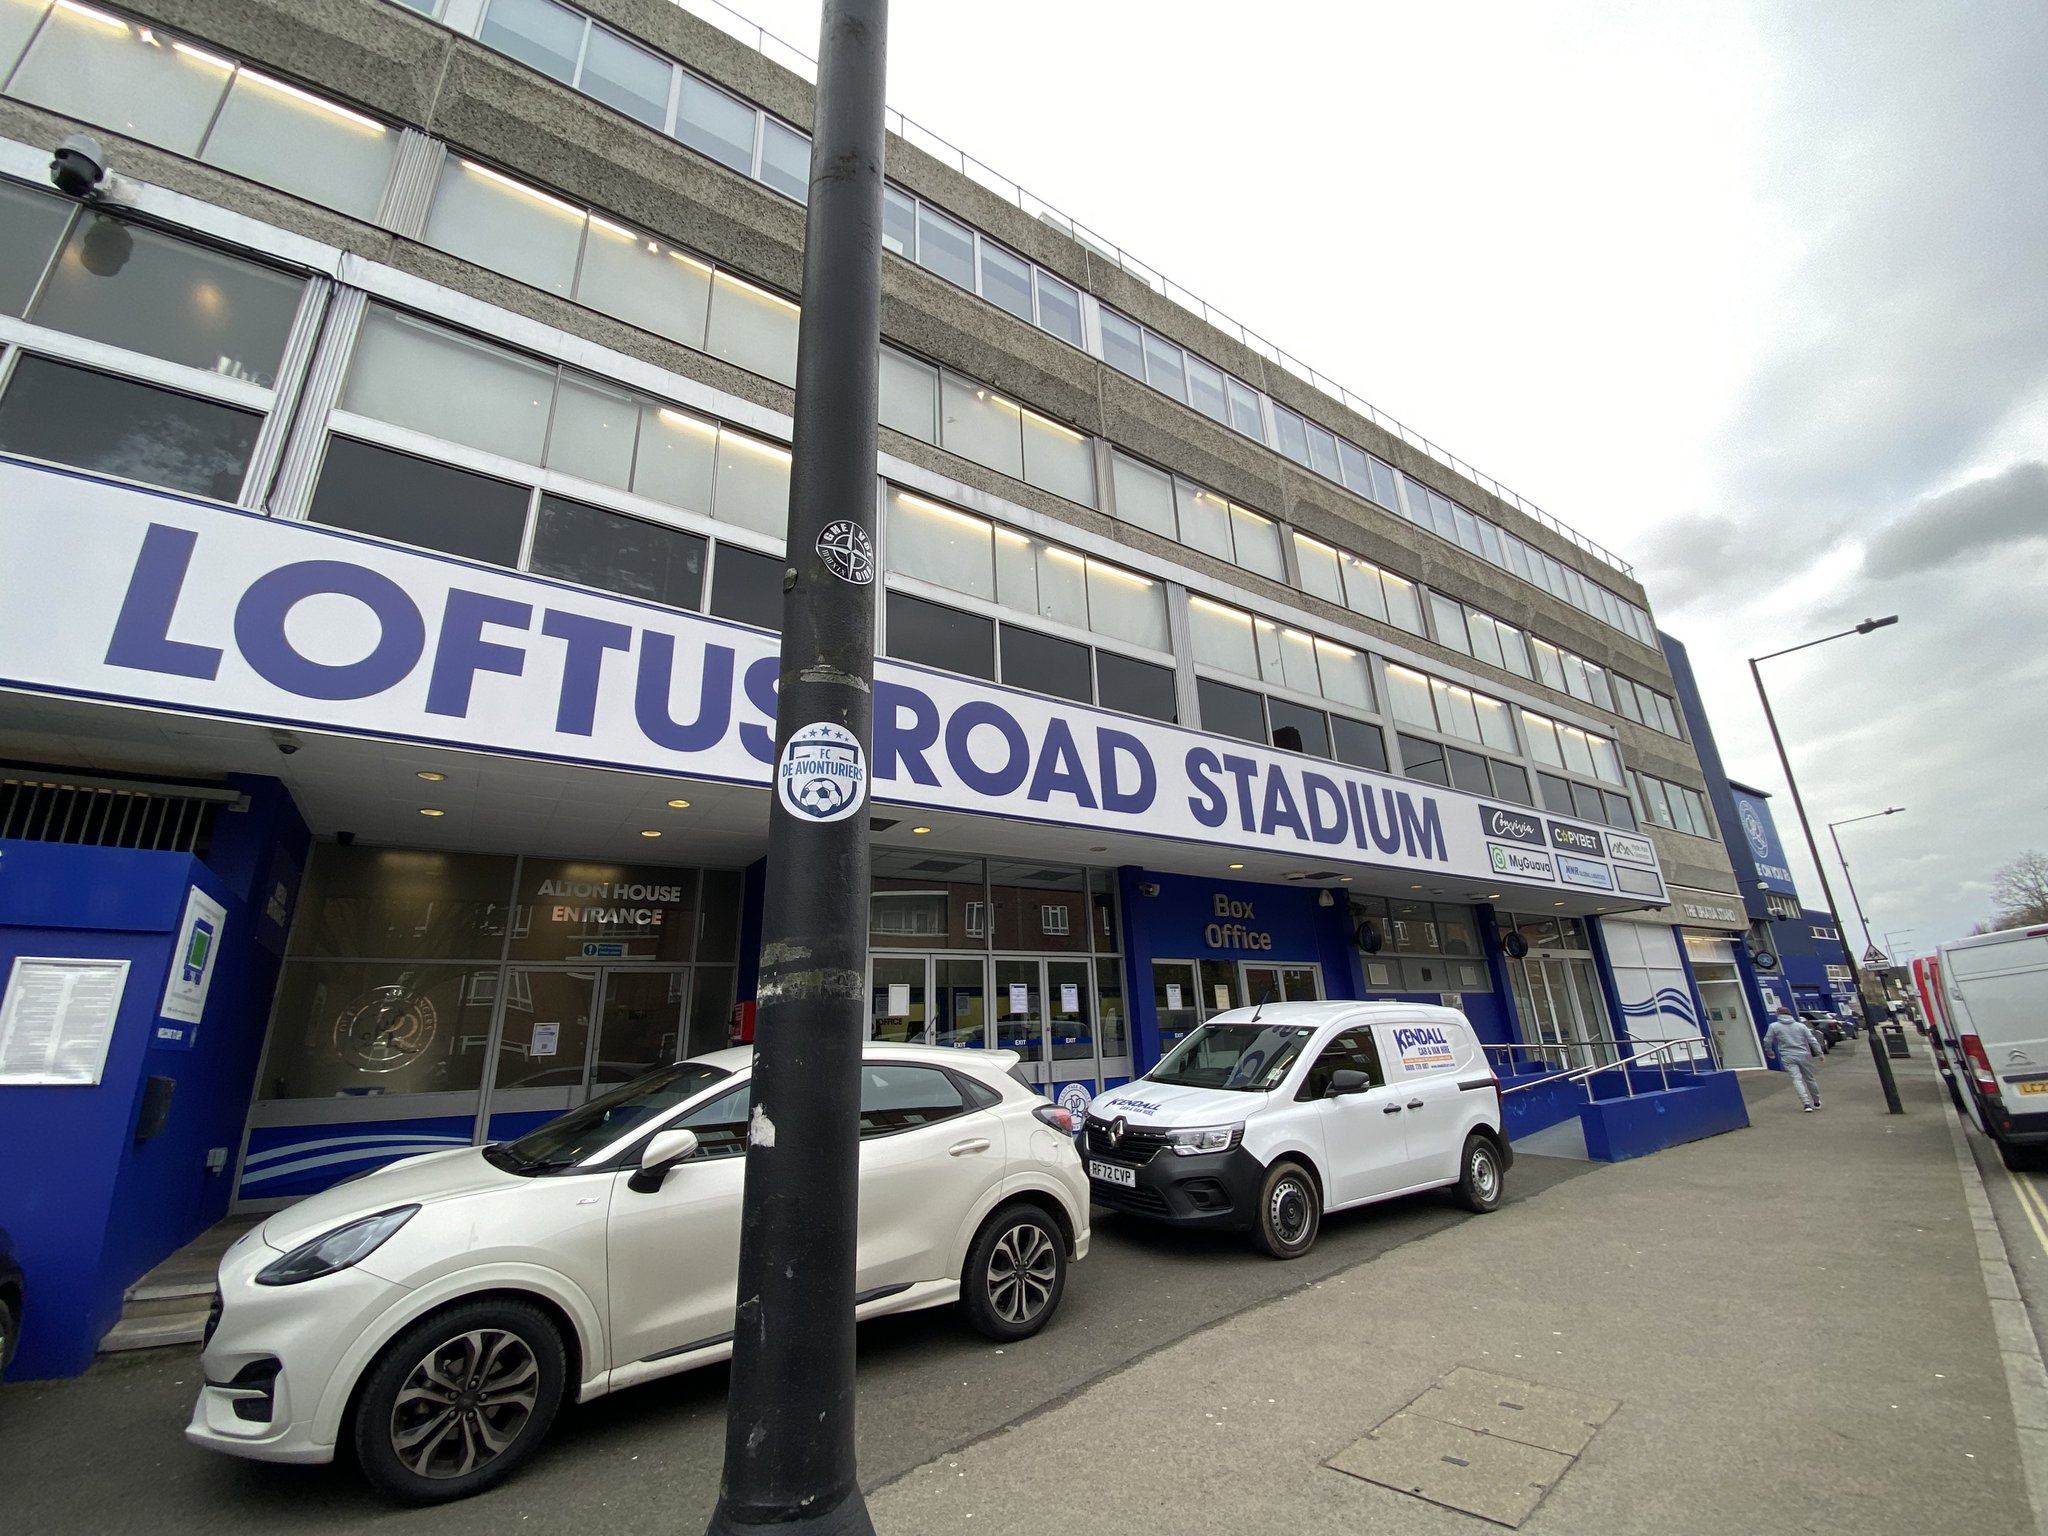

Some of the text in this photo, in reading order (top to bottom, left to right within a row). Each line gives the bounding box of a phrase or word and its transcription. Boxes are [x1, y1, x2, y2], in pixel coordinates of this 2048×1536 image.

[820, 748, 831, 760] FC
[782, 760, 863, 781] DE AVONTURIERS
[872, 679, 1157, 815] ROAD
[1185, 746, 1449, 862] STADIUM
[1508, 854, 1551, 872] MyGuava
[537, 880, 681, 902] ALTON HOUSE
[552, 905, 663, 926] ENTRANCE
[1213, 893, 1256, 920] Box
[1205, 923, 1272, 950] Office
[1392, 1027, 1447, 1057] KENDALL
[1418, 1047, 1428, 1056] CAR
[1432, 1045, 1441, 1055] VAN
[1440, 1045, 1451, 1054] HIRE
[1104, 1098, 1162, 1111] KENDALL
[1093, 1162, 1131, 1183] RF72 CVP
